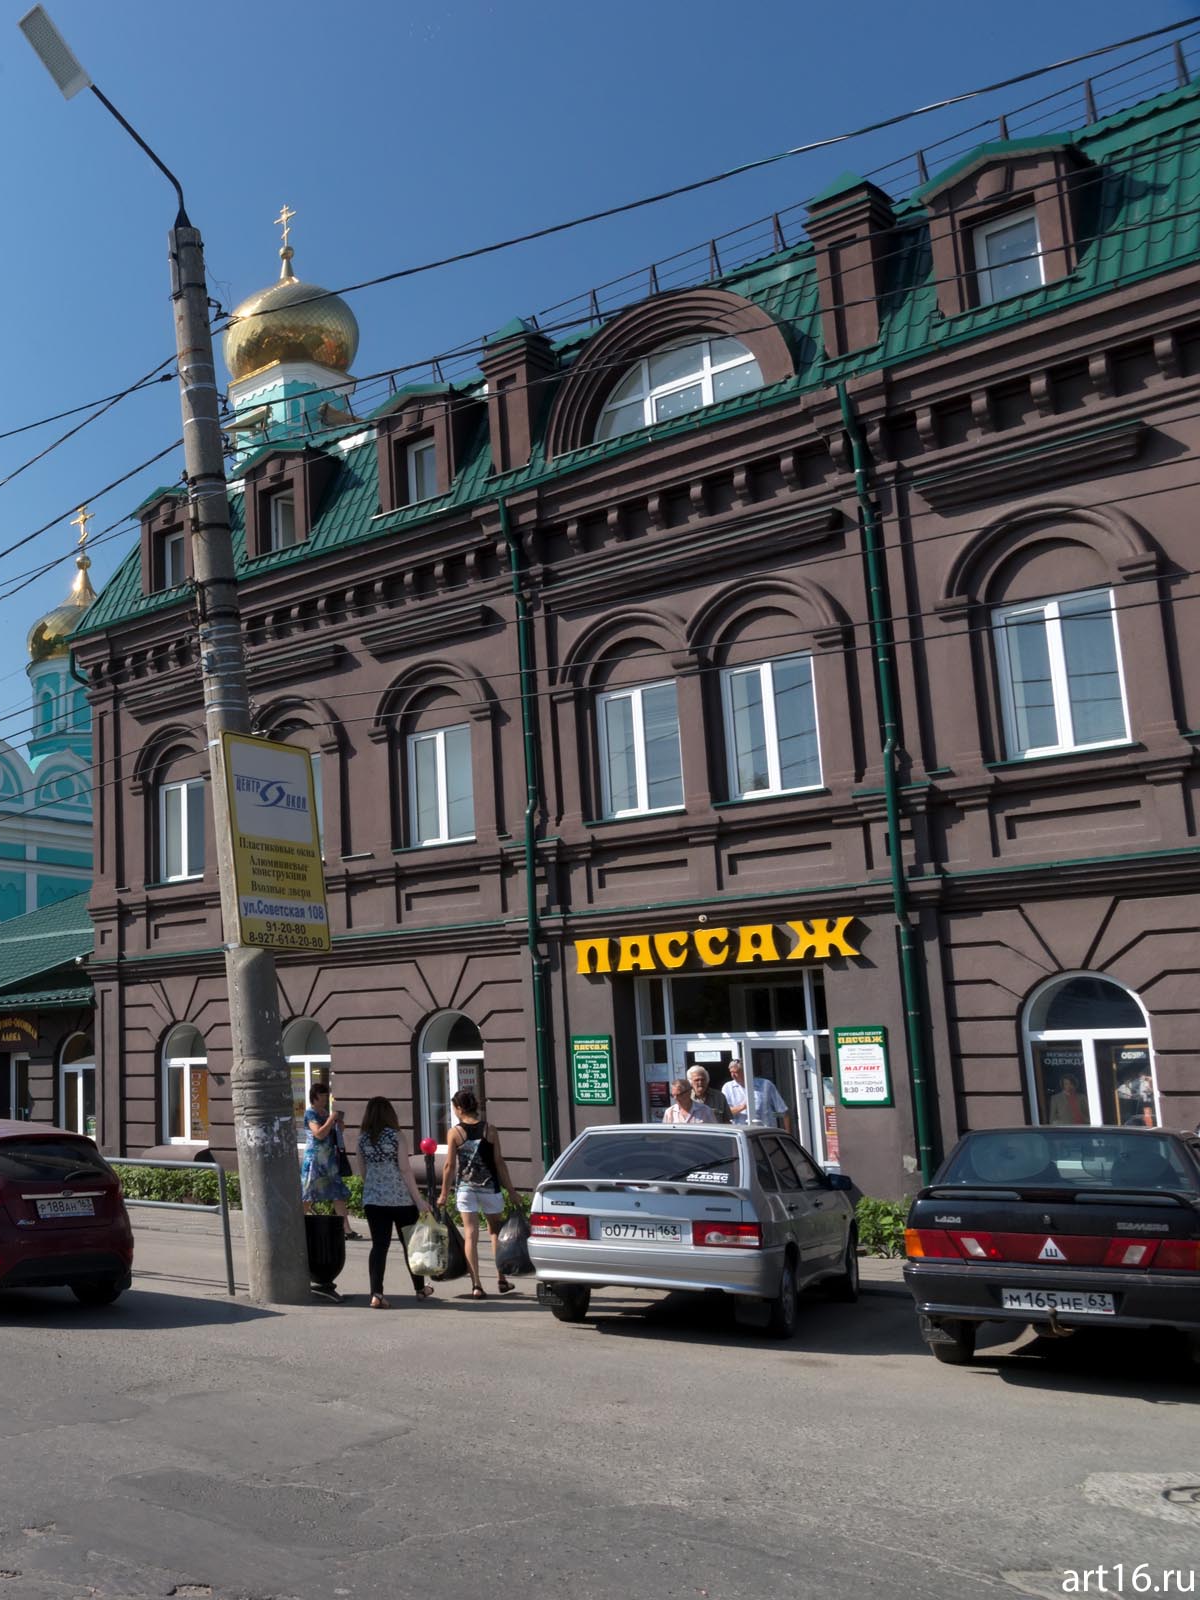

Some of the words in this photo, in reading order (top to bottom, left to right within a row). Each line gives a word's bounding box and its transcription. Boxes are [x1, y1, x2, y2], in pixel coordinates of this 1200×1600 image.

[236, 775, 260, 793] ЦЕНТР
[239, 836, 295, 855] Пластиковые
[296, 848, 316, 858] окна
[249, 855, 308, 872] Алюминиевые
[251, 866, 307, 882] конструкции
[251, 880, 286, 895] Входные
[287, 887, 312, 900] двери
[308, 905, 324, 920] 108
[265, 921, 306, 935] 91-20-80
[249, 931, 323, 948] 8-927-614-20-80
[574, 916, 861, 975] ПАССАЖ
[838, 1036, 883, 1044] ПАССАЖ
[934, 1215, 961, 1224] LADA
[605, 1224, 655, 1239] О077ТН
[658, 1225, 677, 1236] 163
[1045, 1247, 1058, 1258] Ш
[1088, 1294, 1107, 1307] 63
